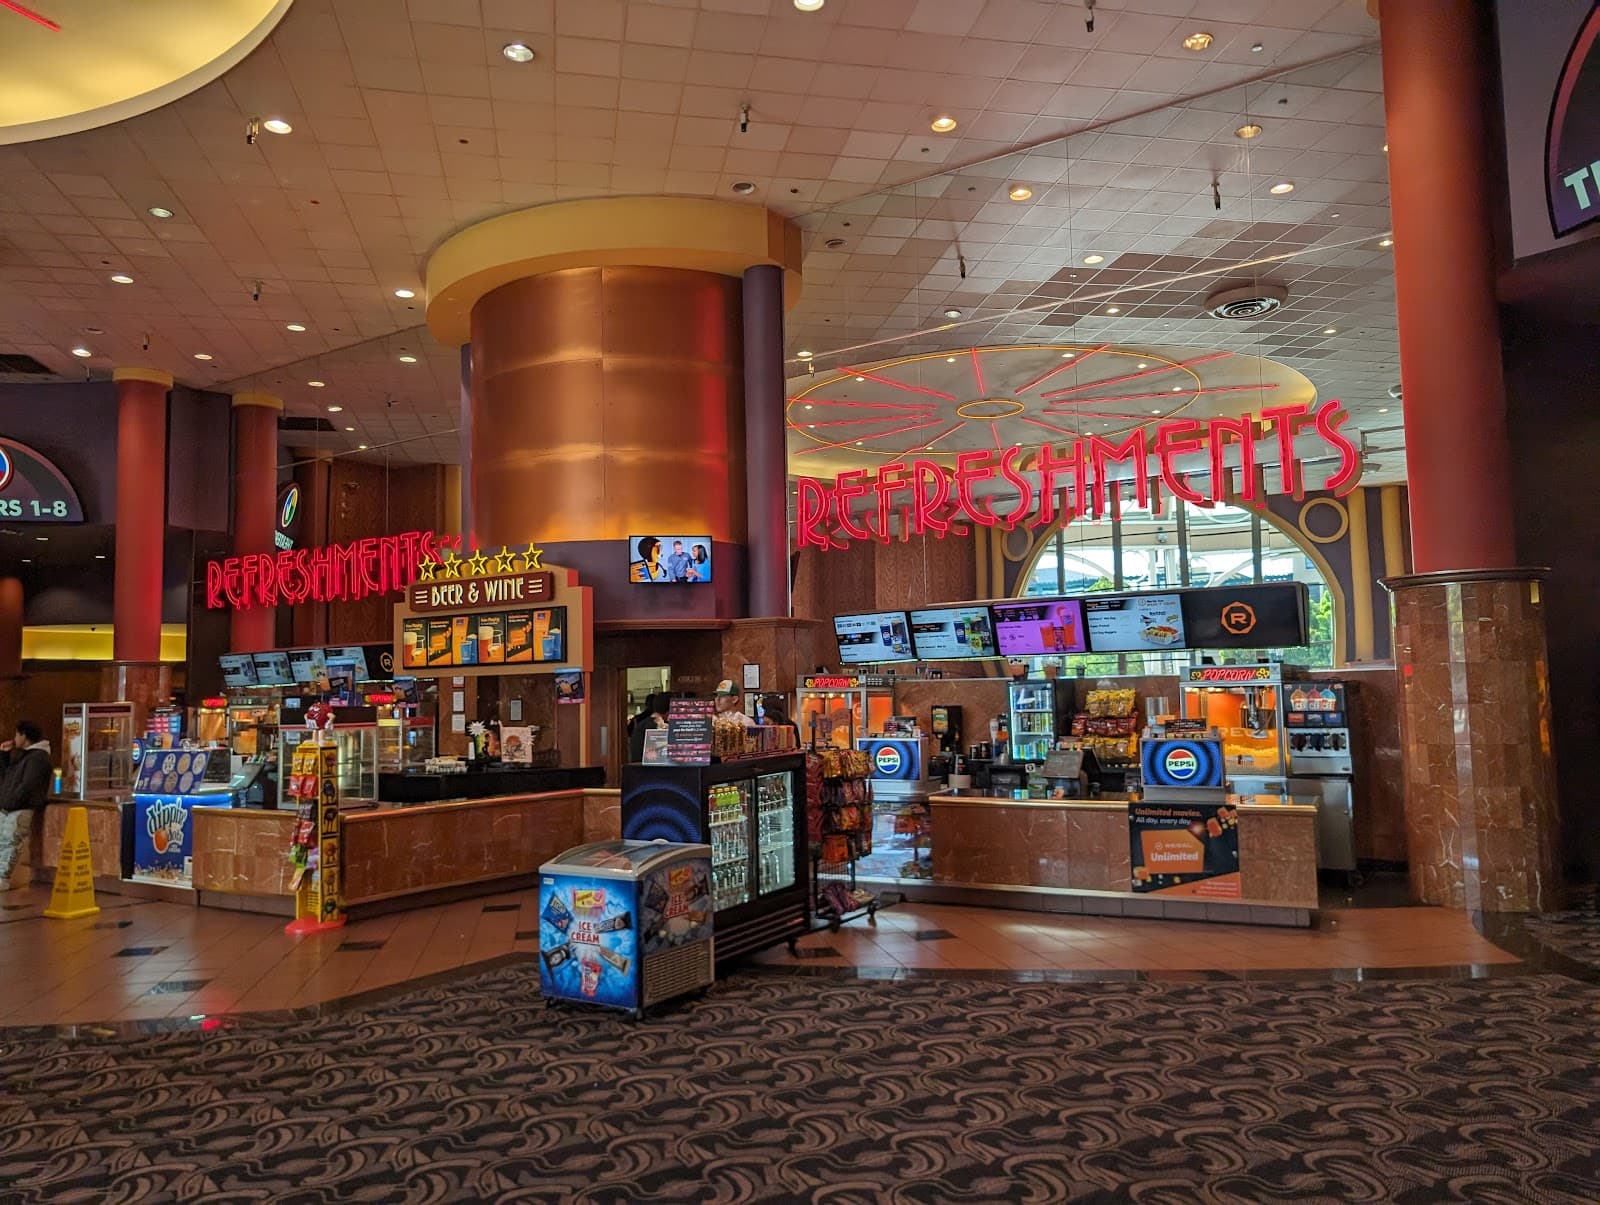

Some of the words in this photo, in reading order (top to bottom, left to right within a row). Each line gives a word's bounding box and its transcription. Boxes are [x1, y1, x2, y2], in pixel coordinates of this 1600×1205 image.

[796, 399, 1362, 548] REFRESHMENTS
[30, 500, 68, 517] 1-8
[207, 531, 444, 609] REFRESHMENTS
[431, 584, 463, 606] BEER
[468, 581, 480, 603] &
[484, 577, 524, 602] WINE
[1203, 668, 1256, 681] POPCORN
[814, 677, 849, 688] POPCORN
[1135, 807, 1172, 816] Unlimited
[1151, 852, 1199, 861] Unlimited
[578, 921, 592, 930] ICE
[571, 931, 600, 943] CREAM
